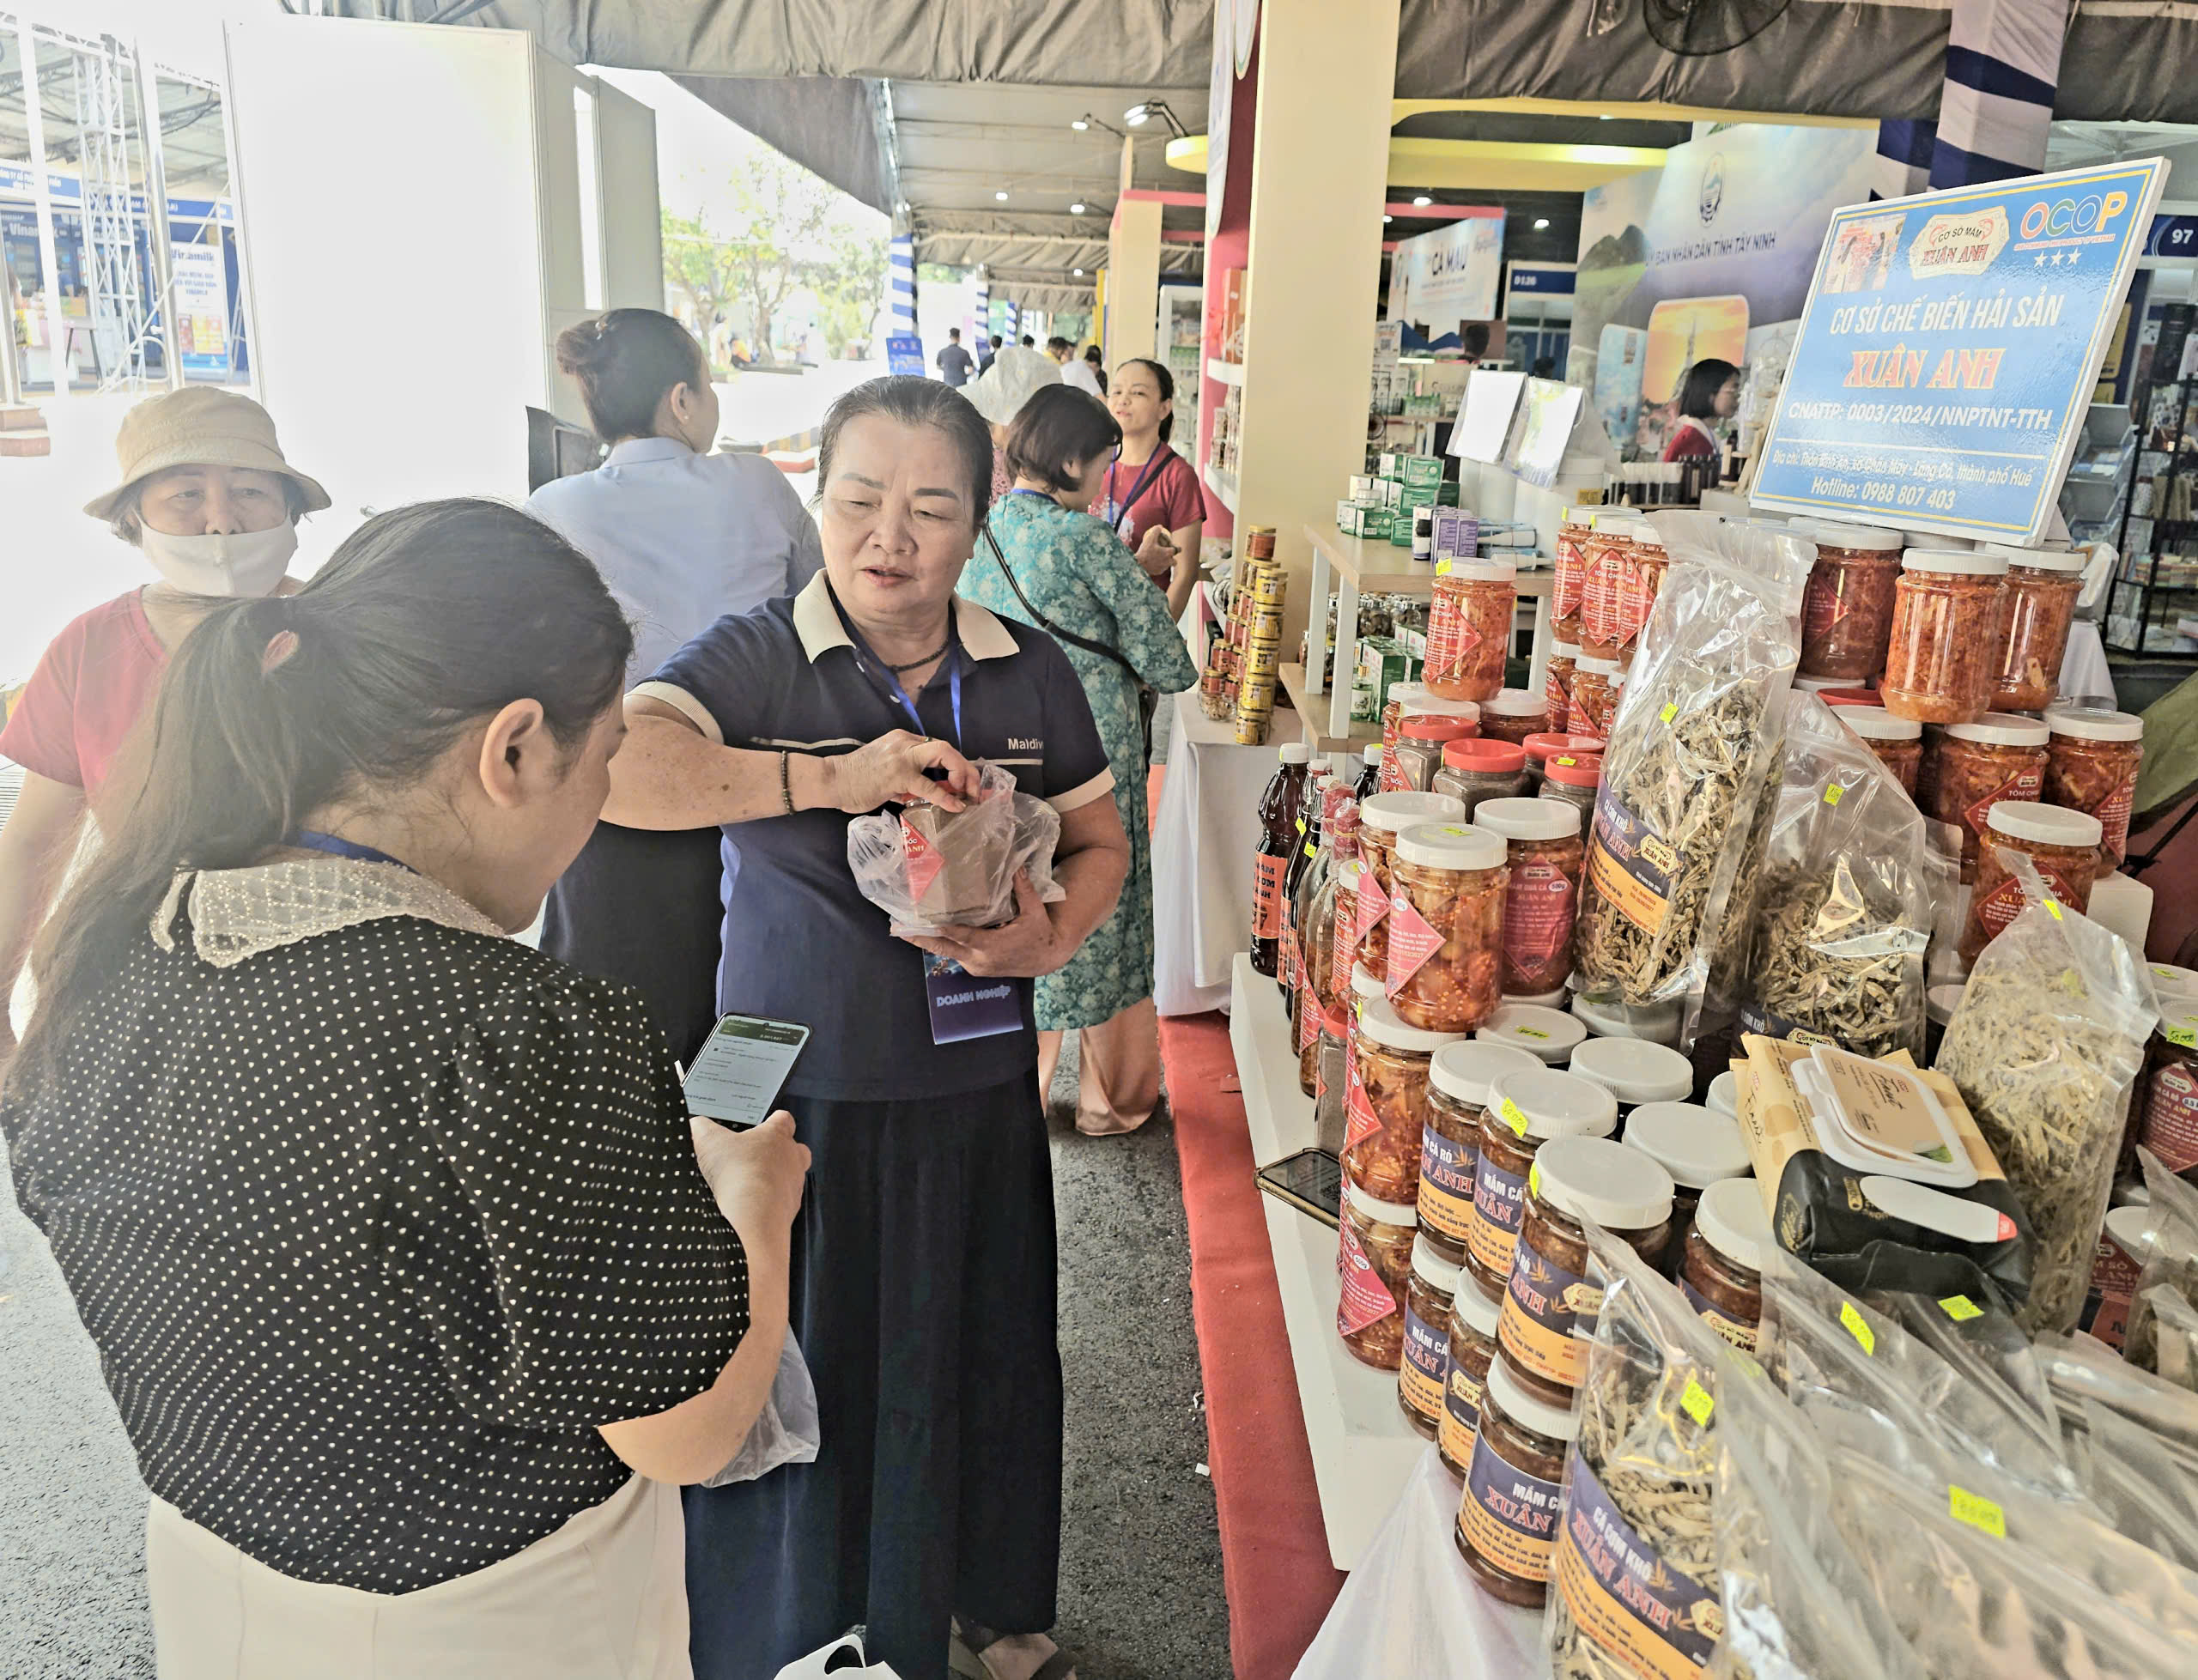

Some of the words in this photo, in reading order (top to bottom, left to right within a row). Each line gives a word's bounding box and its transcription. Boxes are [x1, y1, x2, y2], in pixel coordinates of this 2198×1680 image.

[2020, 191, 2128, 240] OCOP
[1735, 232, 1752, 252] TÂY
[1752, 231, 1777, 249] NINH
[2171, 228, 2194, 244] 97
[1957, 244, 1989, 263] ANH
[1830, 306, 1858, 336] CƠ
[1855, 297, 1881, 333] SỞ
[1881, 294, 1928, 332] CHẾ
[1920, 290, 1971, 331] BIẾN
[1970, 288, 2013, 330] HẢI
[2012, 285, 2065, 327] SẢN
[1843, 343, 1928, 389] XUÂN
[1925, 348, 2007, 390] ANH
[1848, 403, 2053, 430] 0003/2024/NNPTNT-TTH
[1986, 464, 2013, 486] phố
[2010, 466, 2037, 487] Huế
[1811, 476, 1860, 498] Hotline:
[1861, 482, 1896, 503] 0988
[1897, 485, 1926, 506] 807
[1927, 488, 1956, 510] 403
[936, 992, 974, 1007] DOANH
[1432, 1165, 1474, 1194] ANH
[1485, 1173, 1506, 1198] MẮM
[1508, 1186, 1524, 1203] CÁ
[1510, 1271, 1547, 1316] ANH
[1412, 1325, 1432, 1349] MẮM
[1435, 1342, 1448, 1356] CÁ
[1485, 1484, 1553, 1532] XUÂN
[1512, 1483, 1547, 1507] MẮM
[1594, 1506, 1608, 1532] CÁ
[1625, 1548, 1653, 1581] KHÔ
[1571, 1507, 1618, 1582] XUÂN
[1613, 1574, 1673, 1631] ANH
